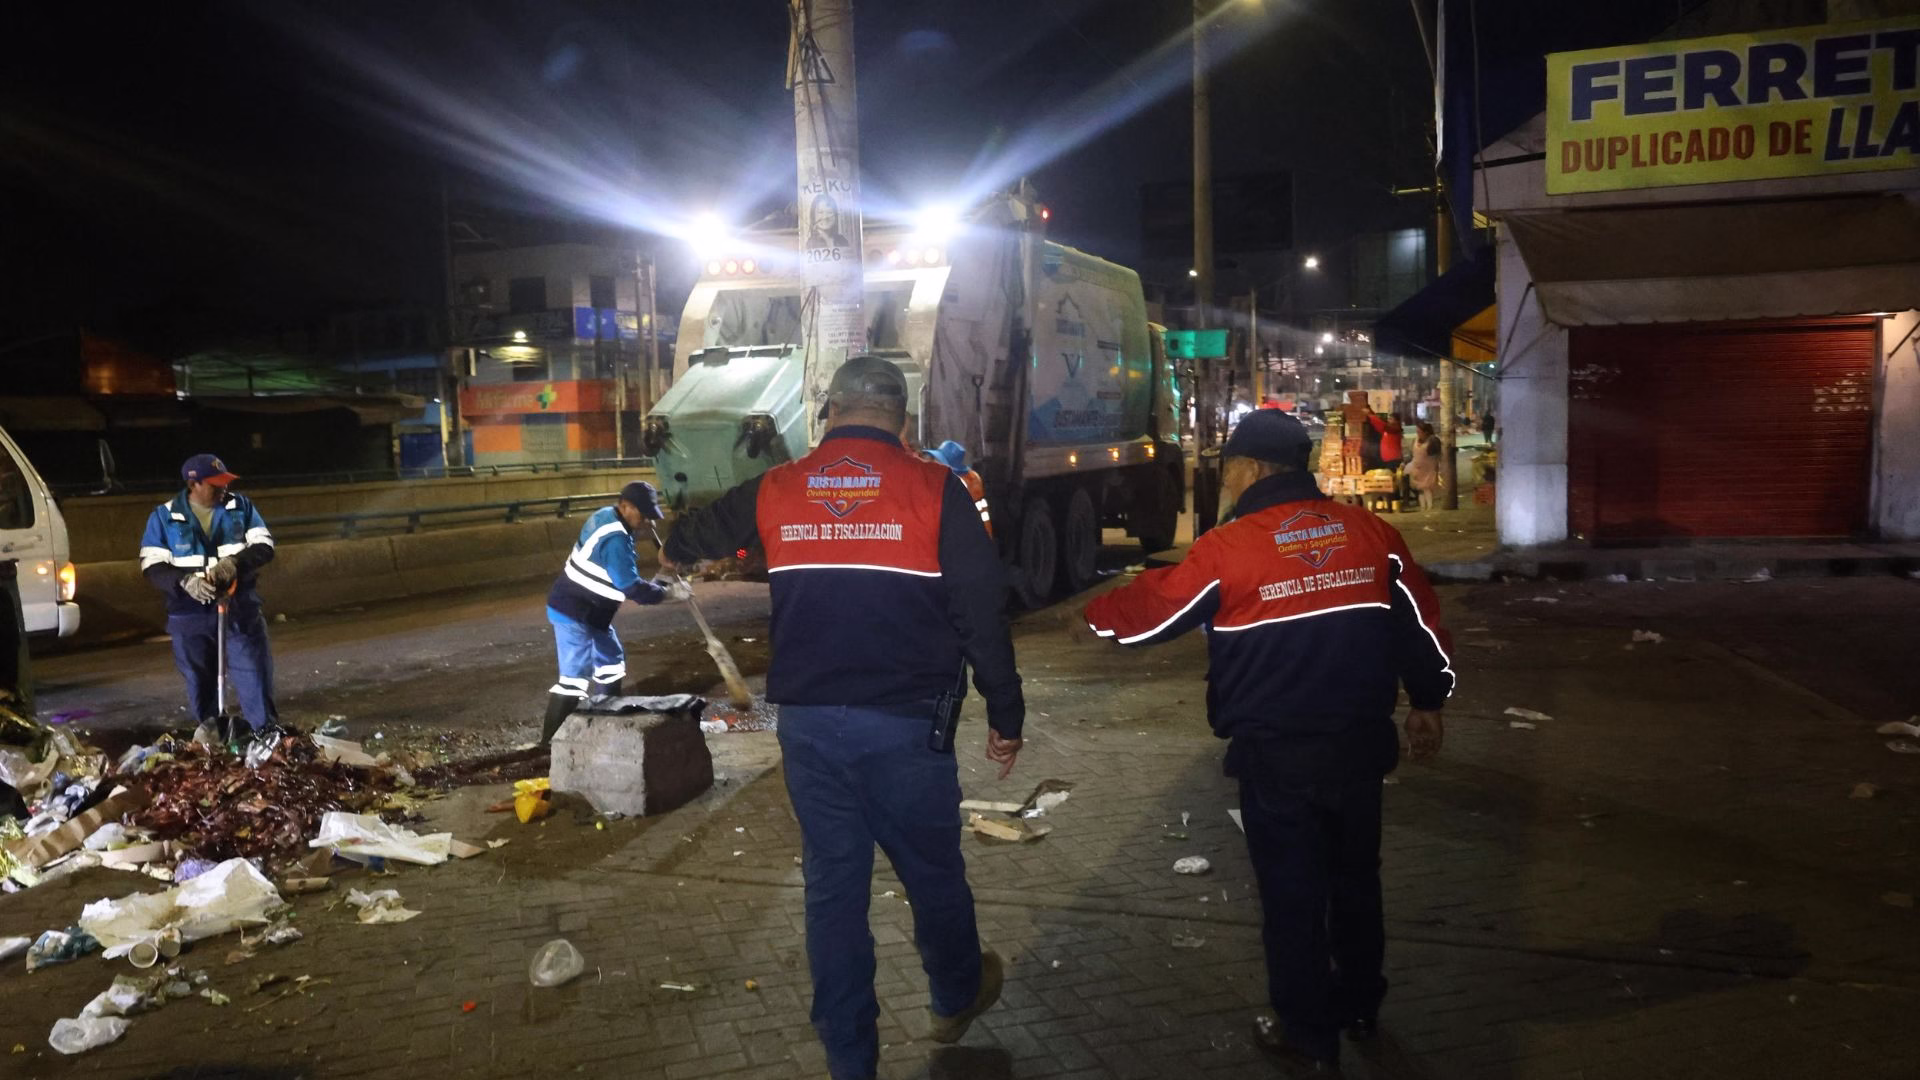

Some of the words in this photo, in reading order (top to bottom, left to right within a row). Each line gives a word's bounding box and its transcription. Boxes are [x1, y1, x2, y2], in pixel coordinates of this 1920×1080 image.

[1571, 29, 1920, 121] FERRET
[1561, 124, 1755, 174] DUPLICADO
[1768, 120, 1812, 157] DE
[1824, 100, 1920, 161] LLA
[807, 247, 841, 263] 2026
[807, 476, 881, 489] BUSTAMANTE
[840, 489, 879, 498] Seguridad
[781, 524, 817, 541] GERENCIA
[820, 524, 832, 540] DE
[833, 518, 903, 541] FISCALIZACIÓN
[1275, 523, 1345, 544] BUSTAMANTE
[1278, 541, 1302, 553] Orden
[1309, 534, 1348, 549] Seguridad
[1258, 580, 1303, 601] GERENCIA
[1303, 576, 1316, 592] DE
